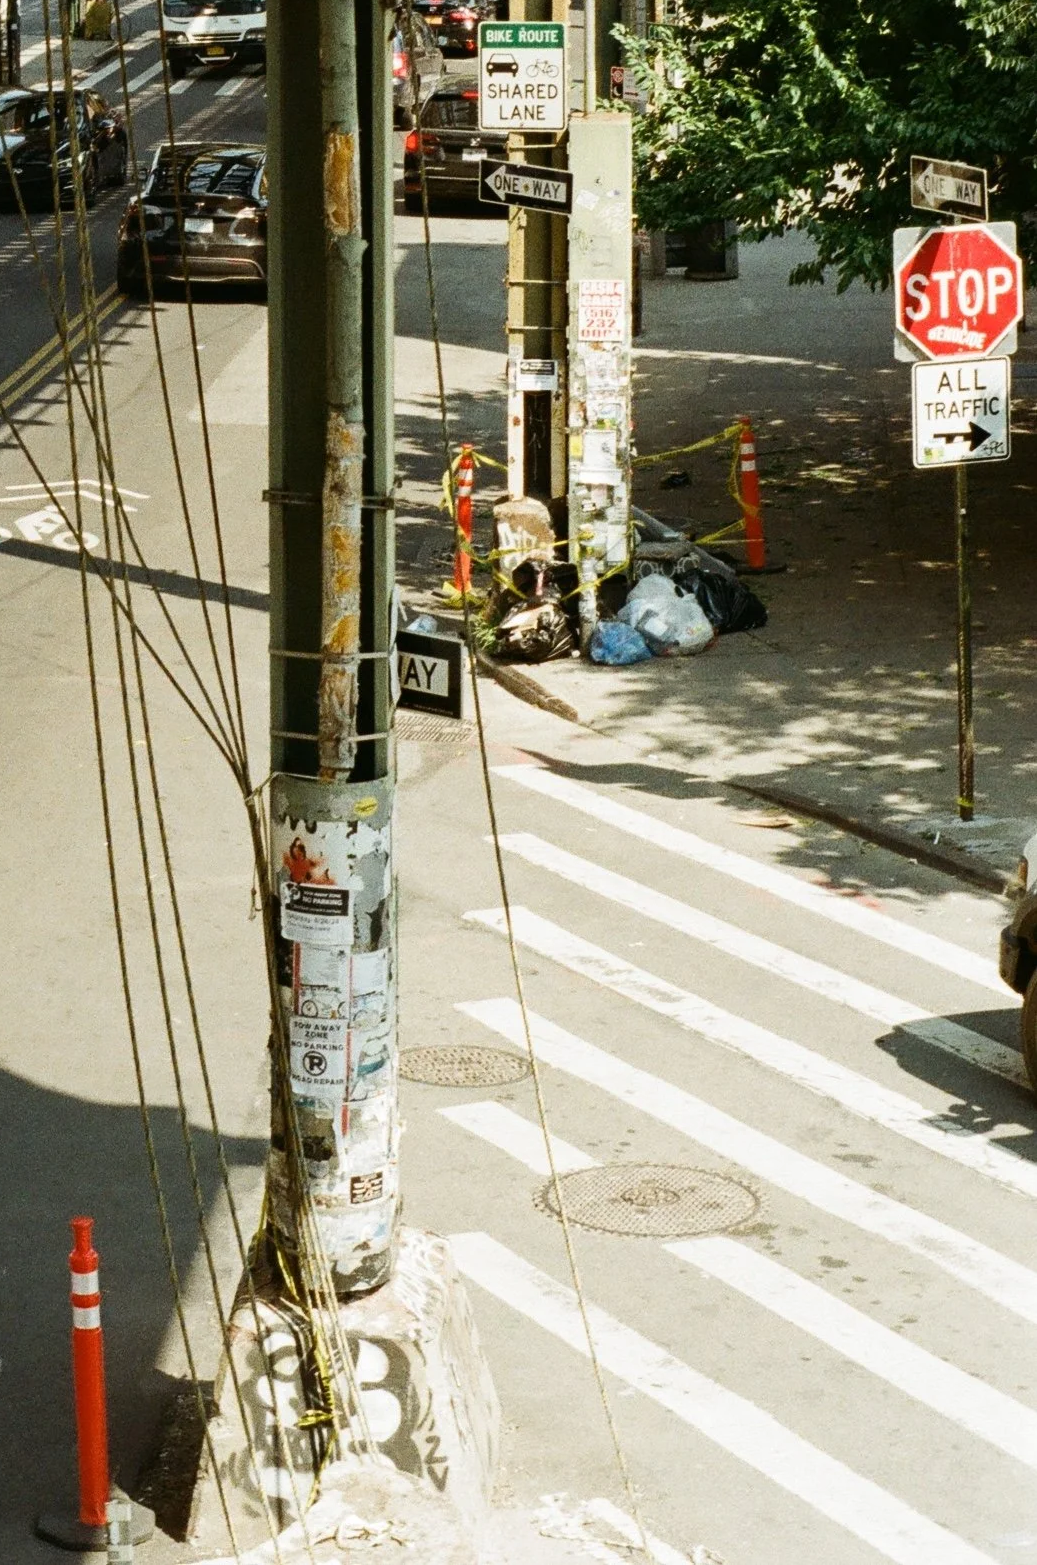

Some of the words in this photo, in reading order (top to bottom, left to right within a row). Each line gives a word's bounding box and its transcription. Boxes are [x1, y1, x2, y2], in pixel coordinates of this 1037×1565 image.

[485, 29, 513, 43] BIKE
[518, 29, 559, 43] ROUTE
[487, 83, 559, 100] SHARED
[499, 105, 546, 121] LANE
[493, 174, 520, 193] ONE
[532, 179, 561, 200] WAY
[923, 174, 946, 197] ONE
[955, 182, 978, 203] WAY
[905, 266, 1013, 322] STOP
[937, 368, 988, 394] ALL
[924, 396, 1001, 421] TRAFFIC
[398, 654, 438, 691] AY
[313, 898, 343, 906] PARKING
[304, 1030, 329, 1039] ZONE
[314, 1024, 341, 1032] AWAY
[291, 1040, 302, 1048] NO
[304, 1042, 344, 1051] PARKING
[313, 1078, 344, 1086] REPAIR
